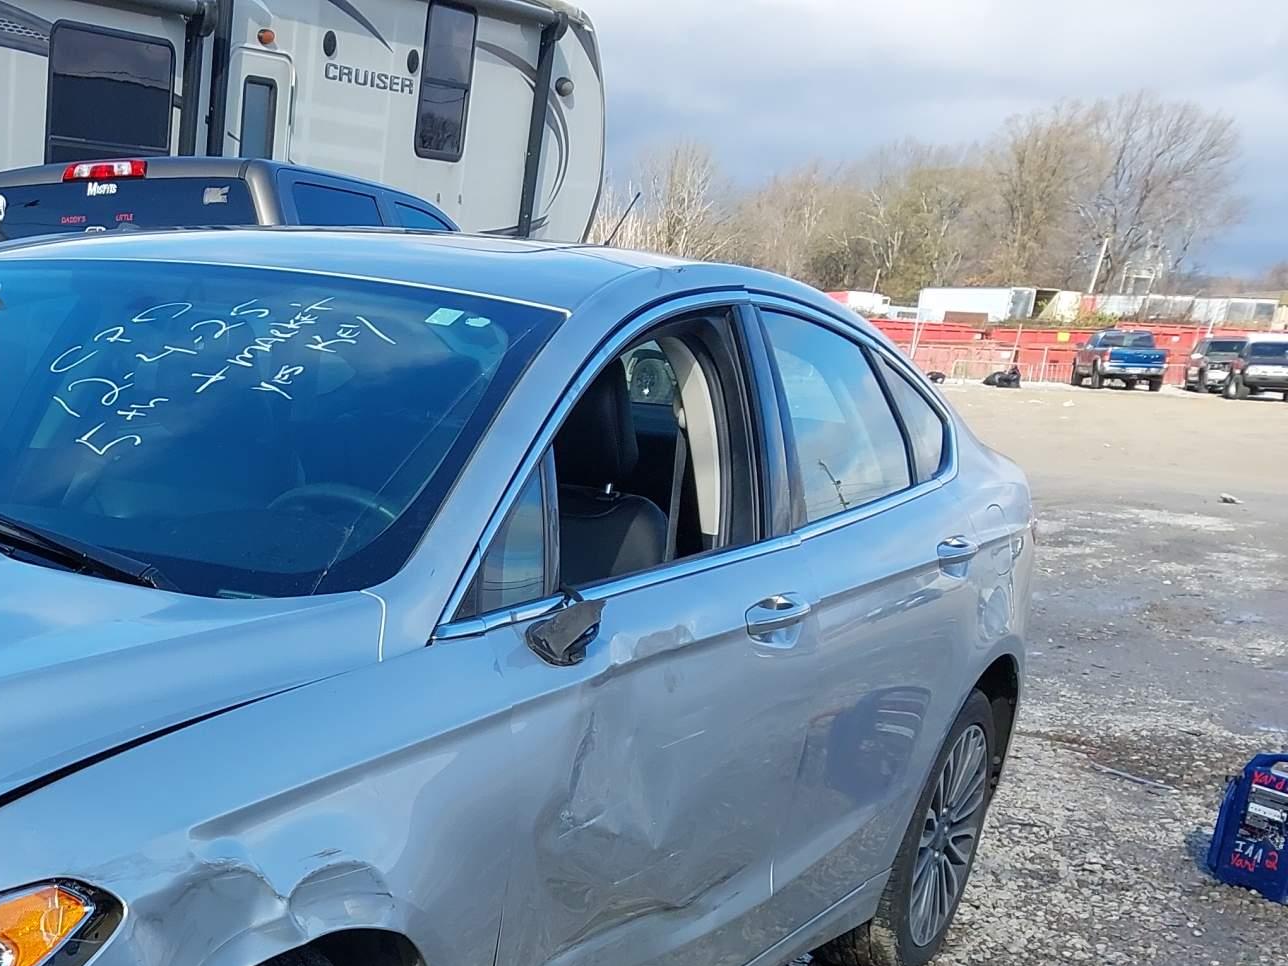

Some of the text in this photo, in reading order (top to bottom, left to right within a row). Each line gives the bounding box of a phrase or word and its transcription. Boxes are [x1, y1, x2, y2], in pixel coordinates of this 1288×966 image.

[324, 62, 414, 95] CRUISER
[75, 397, 169, 455] 5th
[1264, 851, 1279, 871] 2
